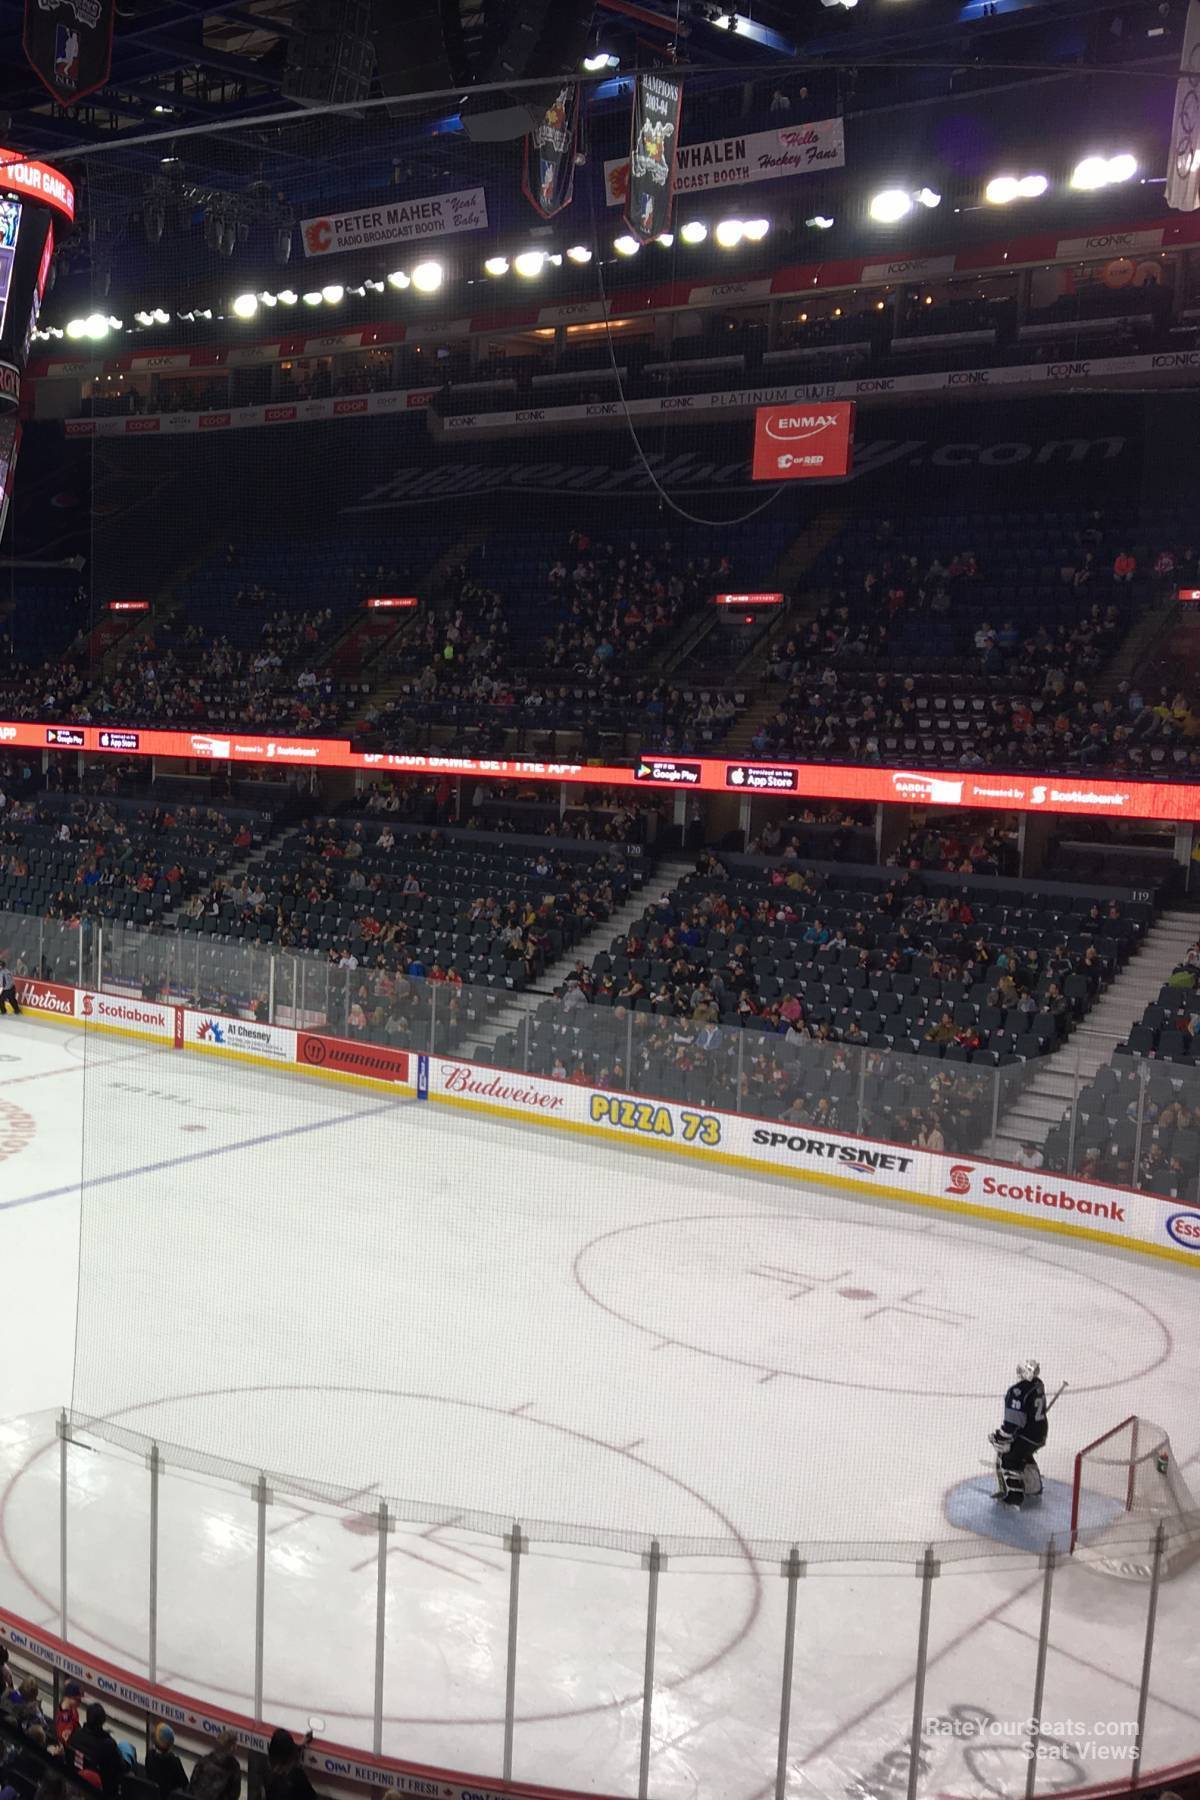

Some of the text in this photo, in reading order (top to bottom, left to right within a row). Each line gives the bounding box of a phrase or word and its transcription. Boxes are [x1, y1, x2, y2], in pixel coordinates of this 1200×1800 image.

[676, 139, 747, 171] WHALEN
[758, 151, 802, 170] Hockey
[7, 163, 42, 190] YOUR
[713, 166, 751, 183] BOOTH
[334, 201, 443, 234] PETER MAHER
[337, 219, 446, 248] RADIO BROADCAST BOOTH
[948, 371, 990, 385] ICONIC
[1047, 361, 1091, 378] ICONIC
[855, 379, 895, 392] ICONIC
[660, 397, 695, 408] ICONIC
[711, 389, 789, 407] PLATINUM
[778, 414, 838, 429] ENMAX
[803, 454, 825, 466] RED
[110, 738, 137, 748] App Store
[653, 768, 699, 784] Google Play
[747, 774, 794, 788] App Store
[973, 785, 1125, 806] Presented by Scotiabank
[19, 982, 73, 1013] Hortons
[97, 1001, 166, 1028] Scotiabank
[237, 1025, 272, 1044] Chesney
[329, 1051, 402, 1073] WARRIOR
[441, 1064, 564, 1110] Budweiser
[590, 1093, 722, 1147] PIZZA 73
[752, 1128, 913, 1175] SPORTSNET
[983, 1177, 1126, 1222] Scotiabank
[1175, 1218, 1200, 1239] Ess
[29, 1641, 84, 1677] KEEPING IT FRESH
[120, 1686, 186, 1723] KEEPING IT FRESH
[354, 1765, 395, 1786] KEEPING
[396, 1774, 407, 1788] IT
[408, 1777, 440, 1797] FRESH
